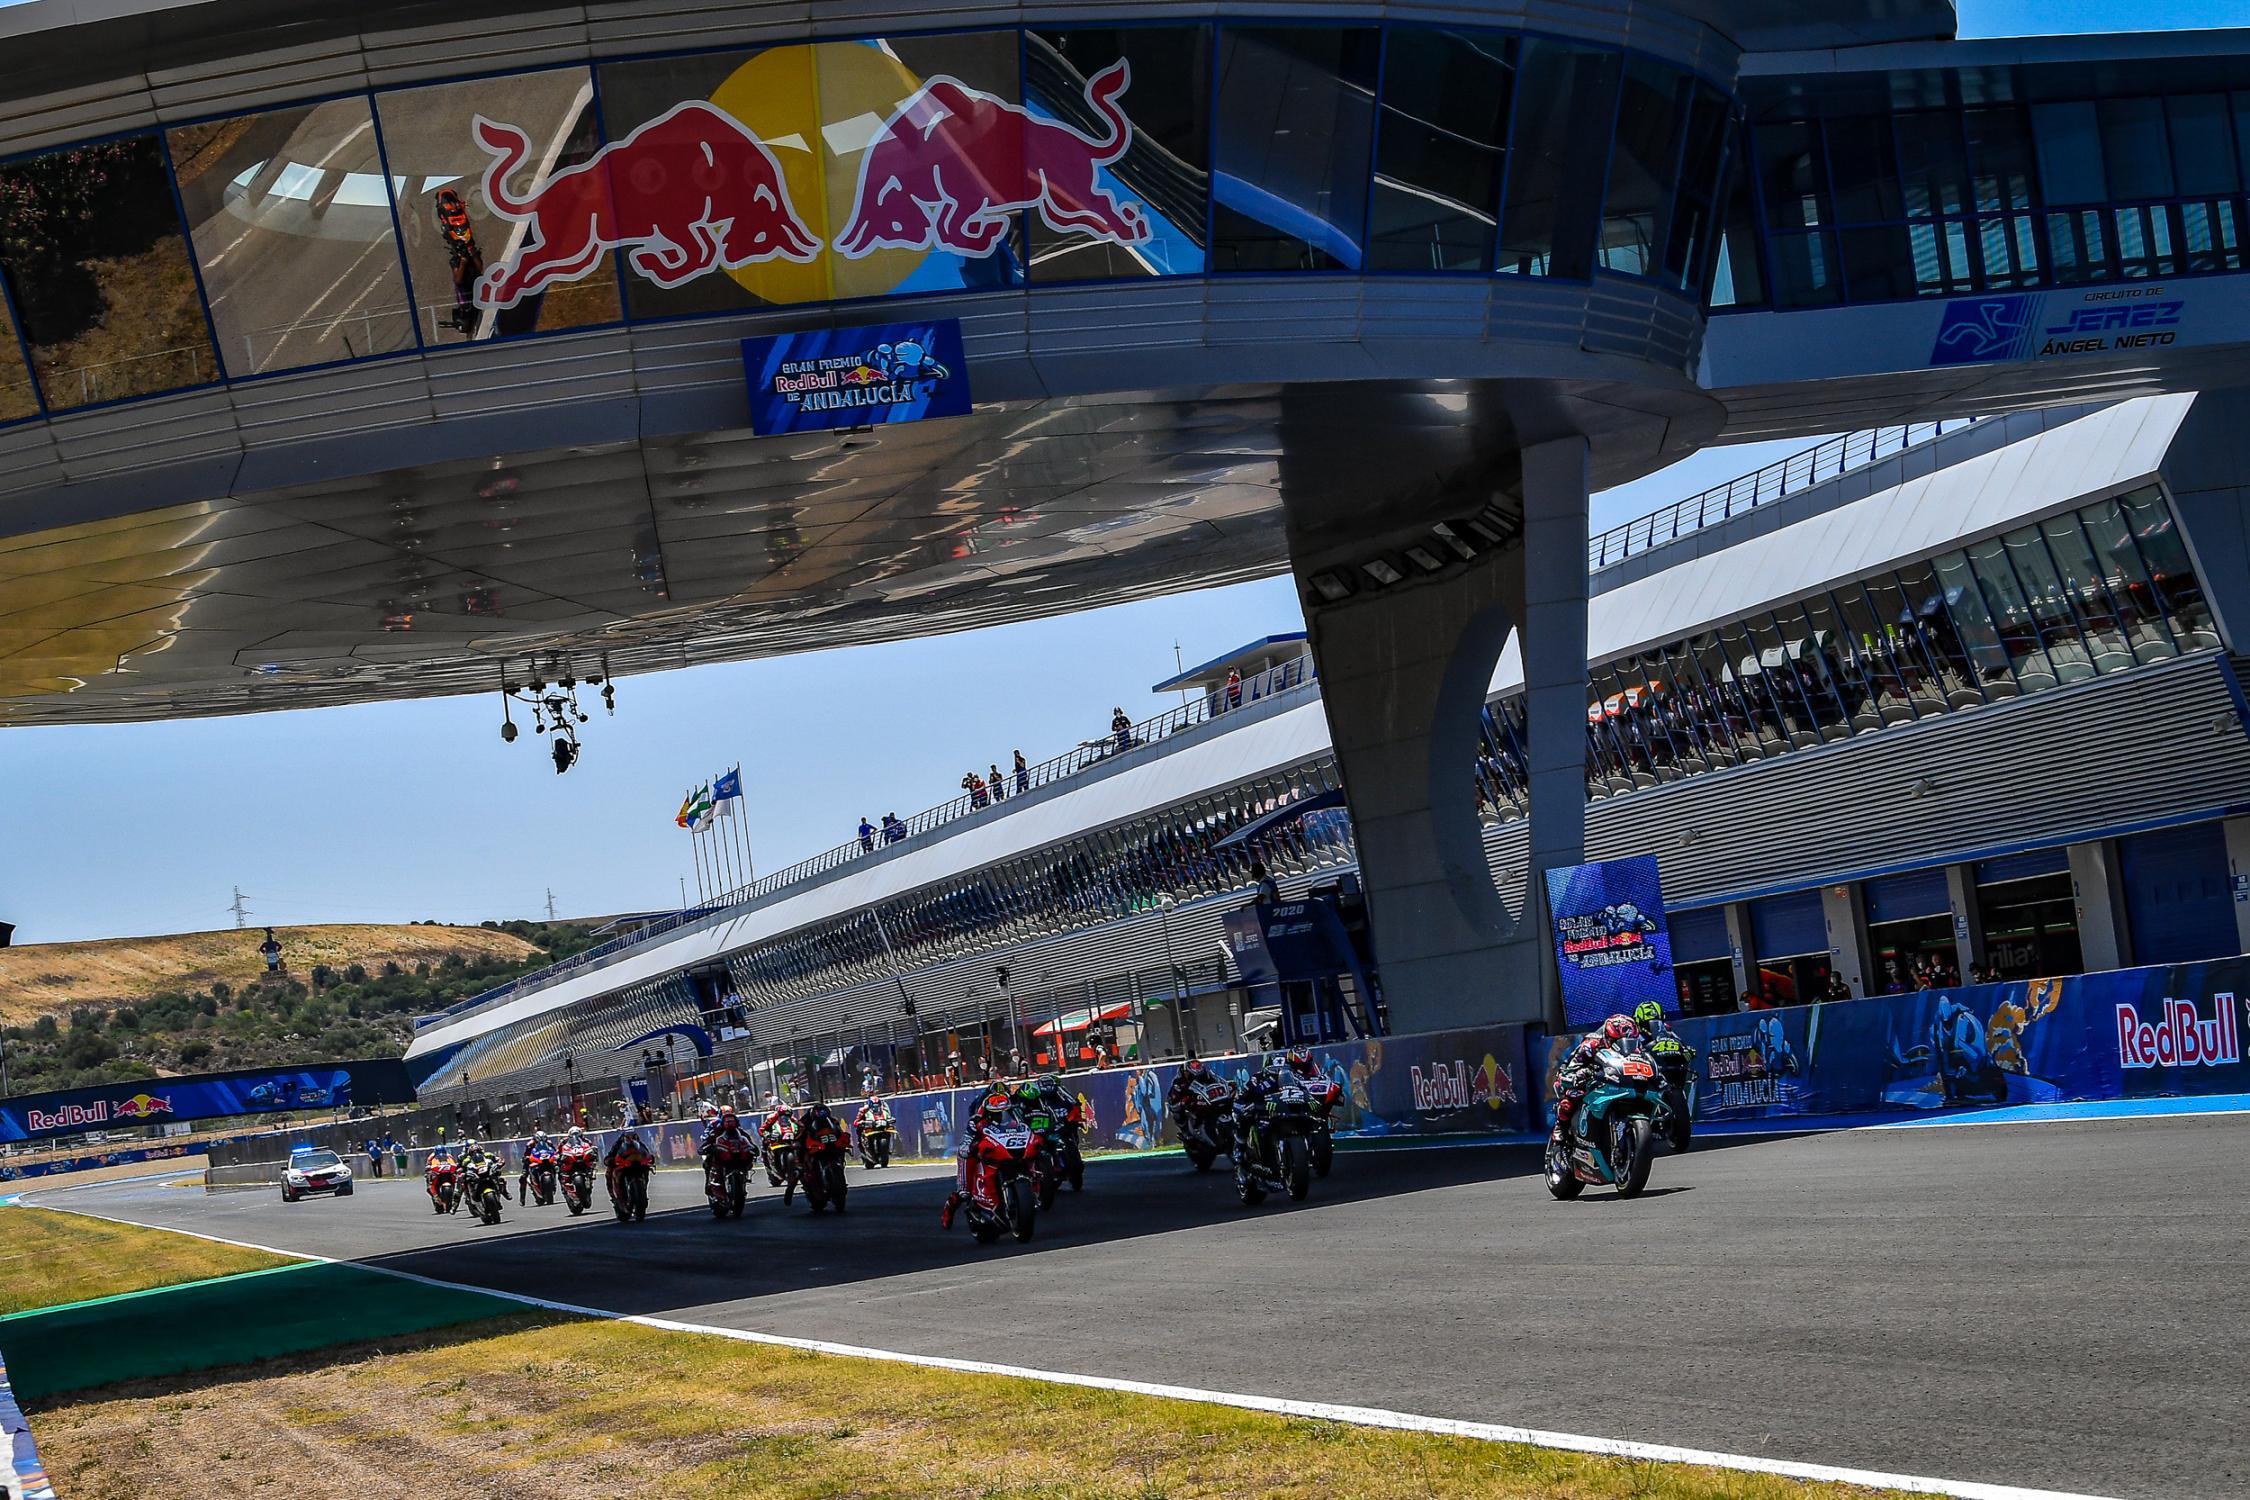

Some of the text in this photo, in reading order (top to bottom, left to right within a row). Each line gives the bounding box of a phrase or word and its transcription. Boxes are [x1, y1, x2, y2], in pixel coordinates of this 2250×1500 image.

[2085, 287, 2164, 302] CIRCUITO DE
[2046, 301, 2185, 335] JEREZ
[2040, 332, 2176, 356] ÁNGEL NIETO
[782, 356, 862, 374] GRAN PREMIO
[787, 381, 913, 411] DE ANDALUCÍA
[1272, 904, 1305, 917] 2020
[1652, 1040, 1680, 1053] 46
[1623, 1062, 1654, 1078] 20
[1280, 1089, 1304, 1100] 12
[1006, 1137, 1028, 1148] 63
